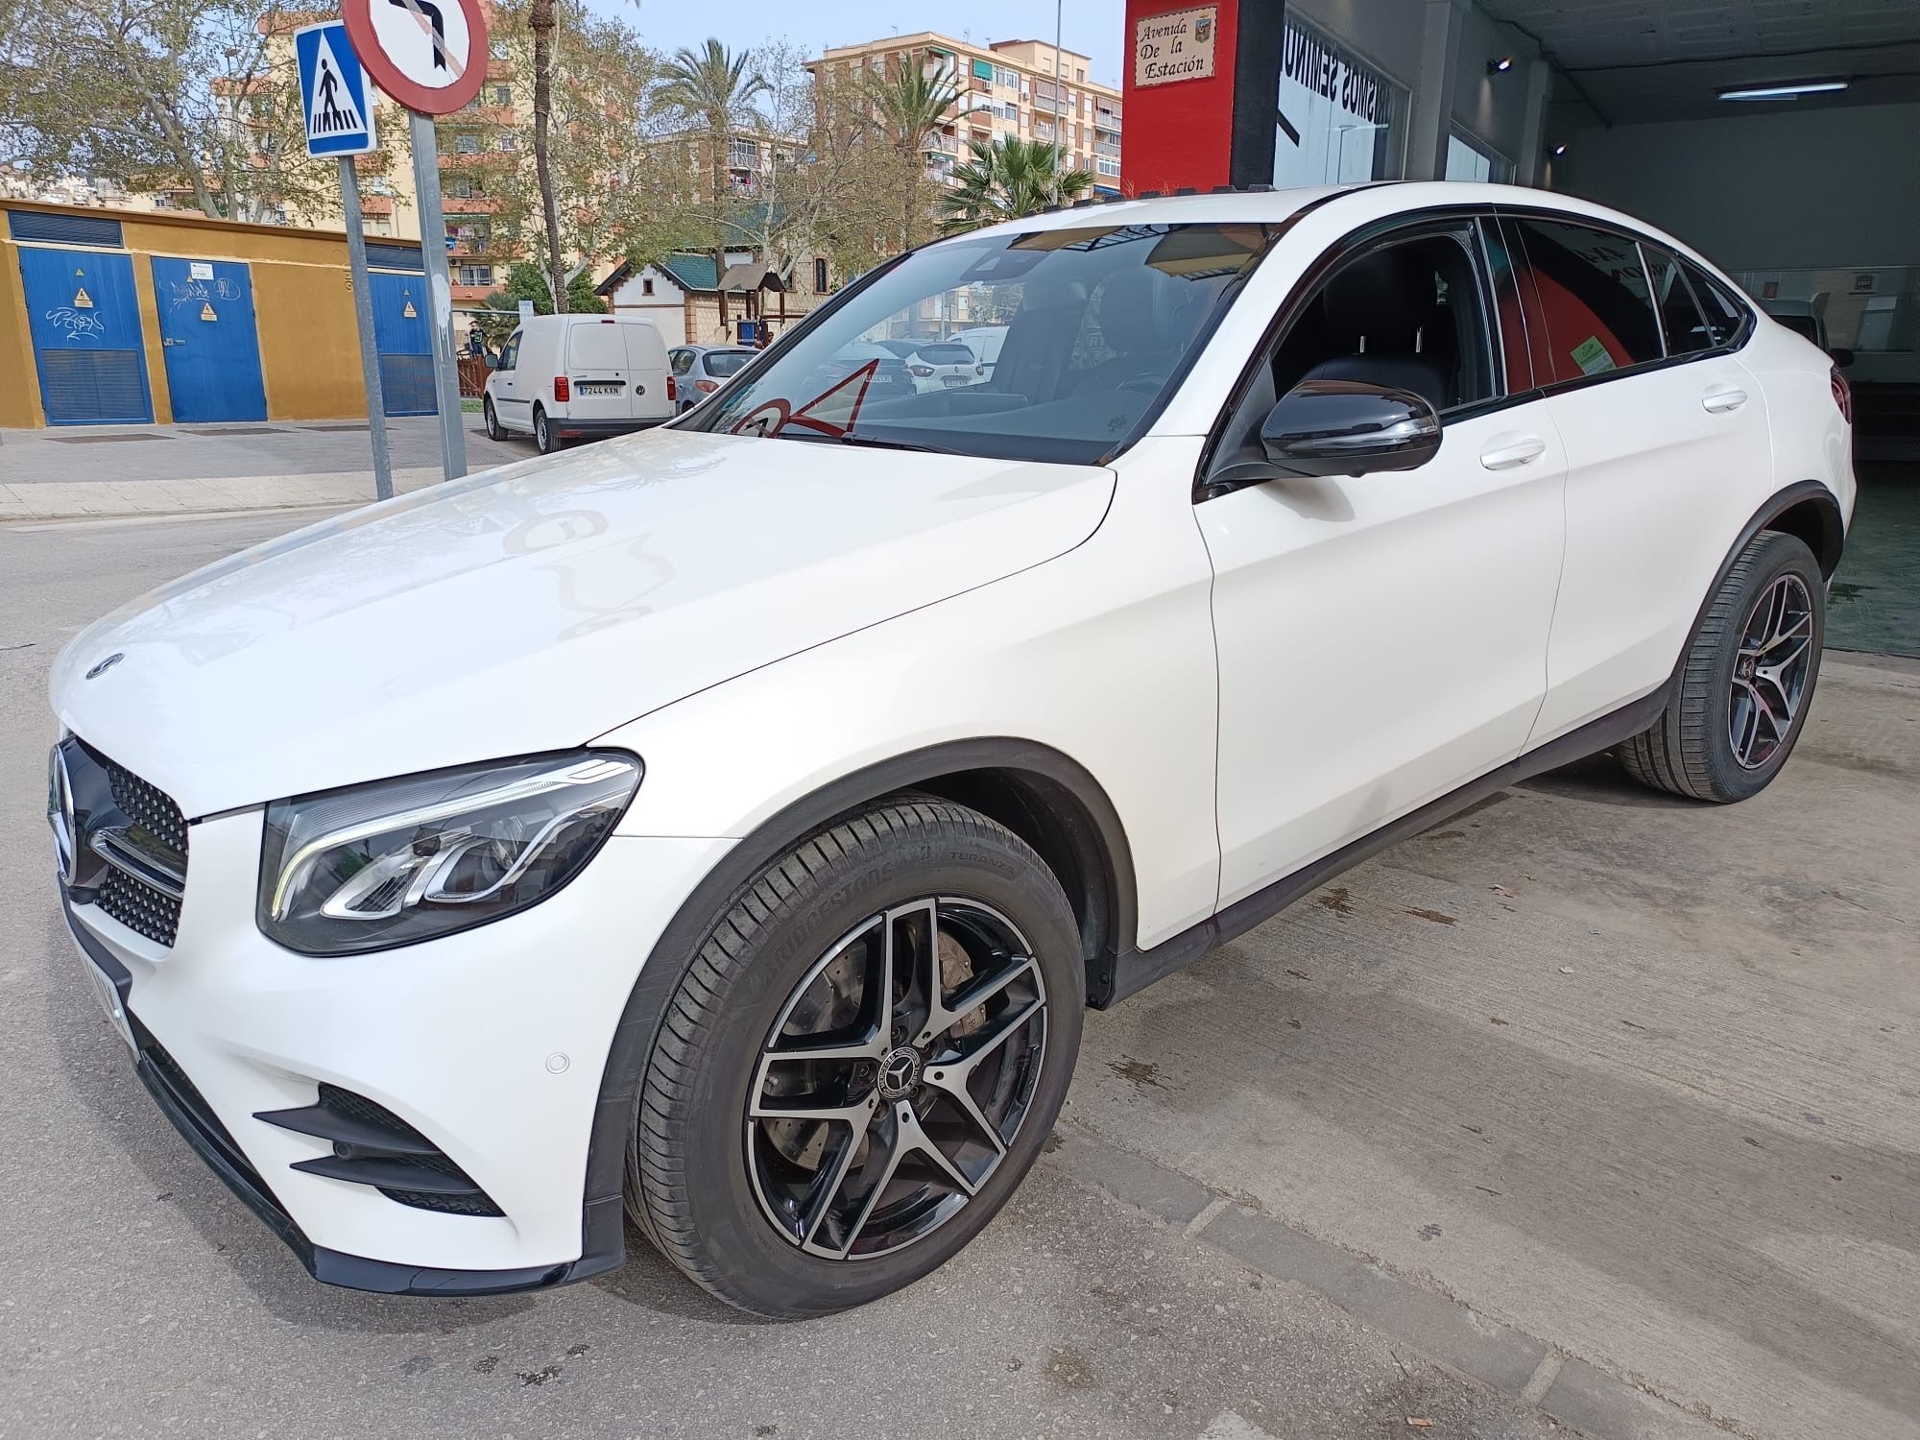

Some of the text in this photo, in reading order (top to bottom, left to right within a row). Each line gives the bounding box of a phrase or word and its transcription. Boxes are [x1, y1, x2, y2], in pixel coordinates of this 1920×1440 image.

[1140, 18, 1187, 42] Avenida
[1140, 35, 1183, 60] De la
[1145, 55, 1204, 79] Estación
[583, 387, 619, 395] 7244 KXN
[949, 851, 1015, 875] TURANZA
